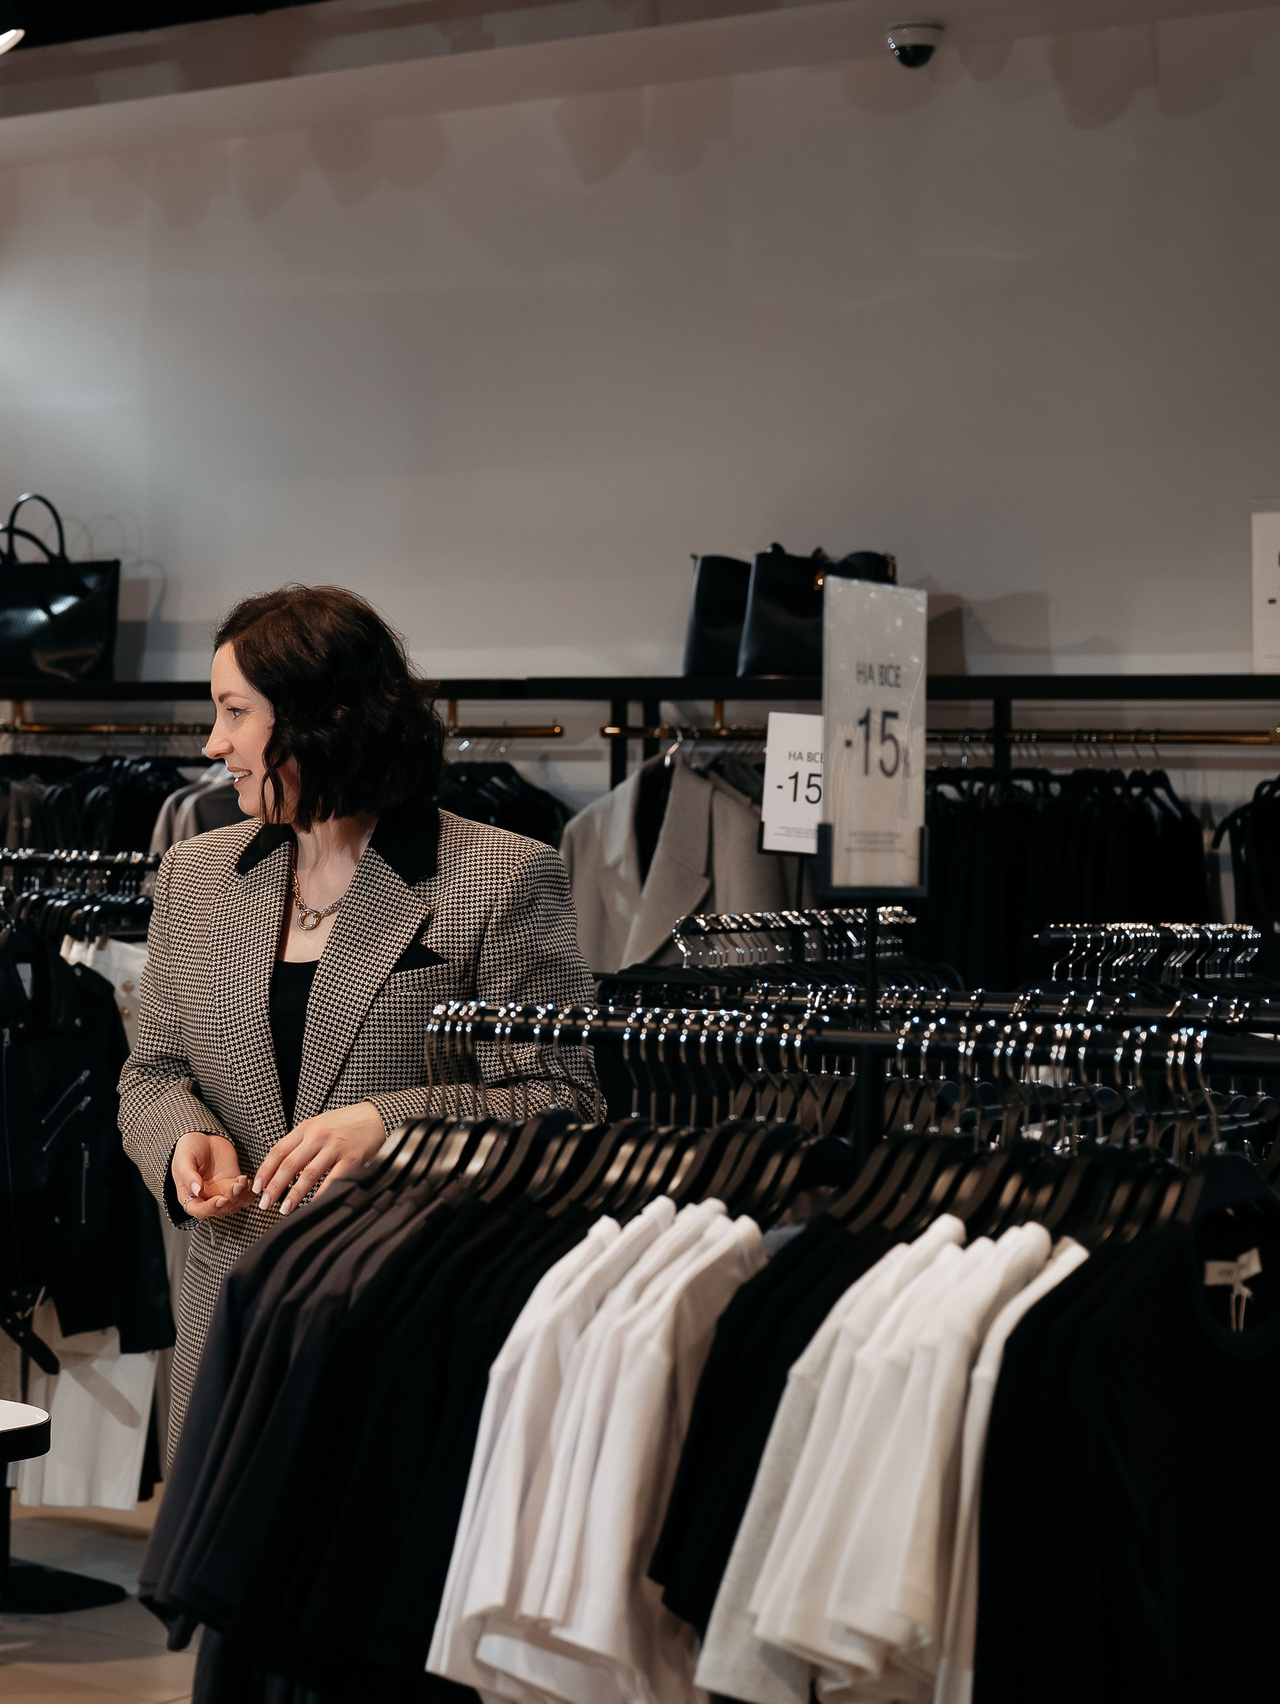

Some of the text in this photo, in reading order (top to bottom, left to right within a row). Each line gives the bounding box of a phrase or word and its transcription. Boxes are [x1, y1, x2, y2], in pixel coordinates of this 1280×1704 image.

[855, 662, 902, 688] НА ВСЕ
[788, 750, 804, 762] НА
